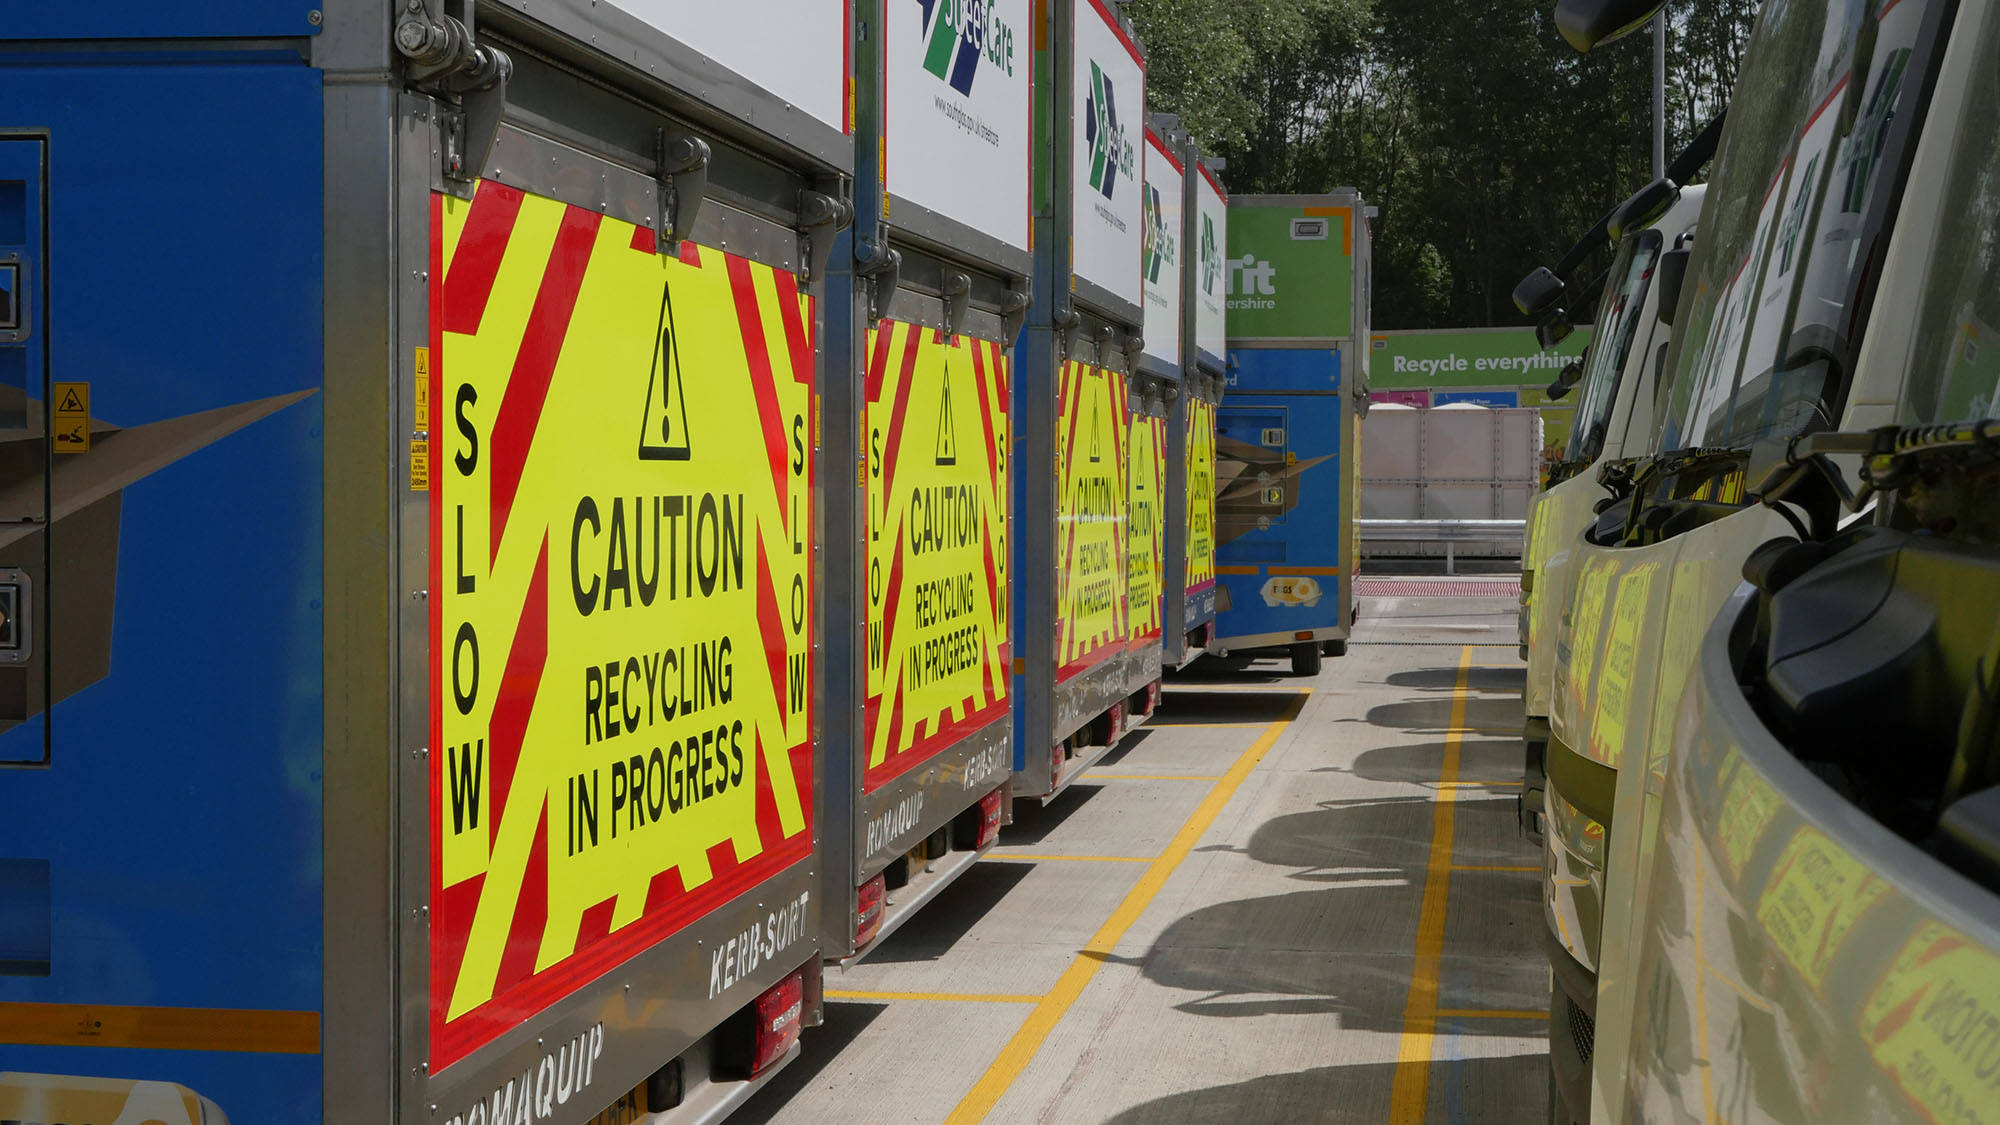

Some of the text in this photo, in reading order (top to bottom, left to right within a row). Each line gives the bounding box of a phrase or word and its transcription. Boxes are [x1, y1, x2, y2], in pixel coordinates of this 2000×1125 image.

[1393, 354, 1468, 376] Recycle
[870, 428, 881, 671] SLOW
[910, 484, 978, 556] CAUTION
[1077, 477, 1112, 525] CAUTION
[570, 492, 743, 617] CAUTION
[789, 413, 805, 715] SLOW
[916, 572, 973, 630] RECYCLING
[1080, 540, 1109, 577] RECYCLING
[448, 383, 483, 835] SLOW
[909, 624, 978, 692] IN PROGRESS
[585, 636, 732, 745] RECYCLING
[568, 719, 743, 857] IN PROGRESS
[866, 788, 924, 858] ROMAQUIP
[708, 890, 809, 1001] KERB-SORT
[446, 1021, 604, 1125] MAQUIP
